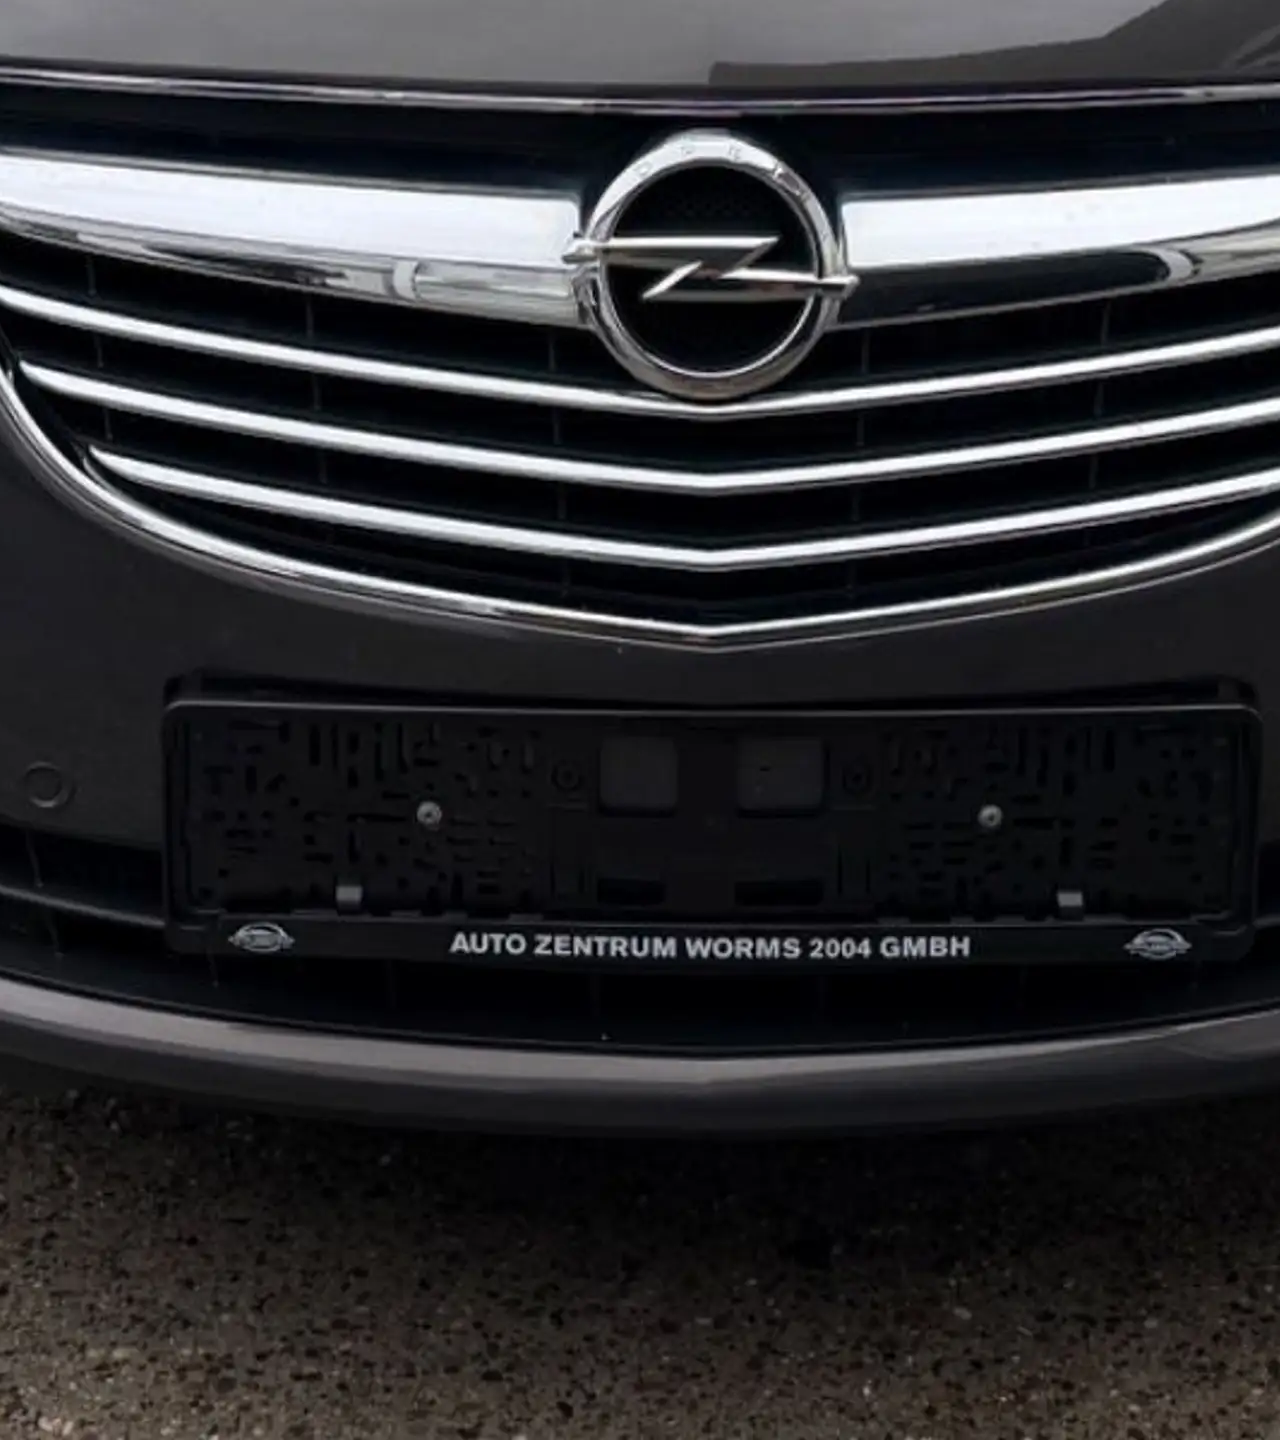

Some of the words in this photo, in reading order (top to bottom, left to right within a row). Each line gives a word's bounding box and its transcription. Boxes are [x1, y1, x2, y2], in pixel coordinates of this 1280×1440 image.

[449, 932, 527, 955] AUTO
[533, 933, 677, 958] ZENTRUM
[684, 936, 802, 959] WORMS
[809, 937, 872, 959] 2004
[879, 935, 970, 958] GMBH
